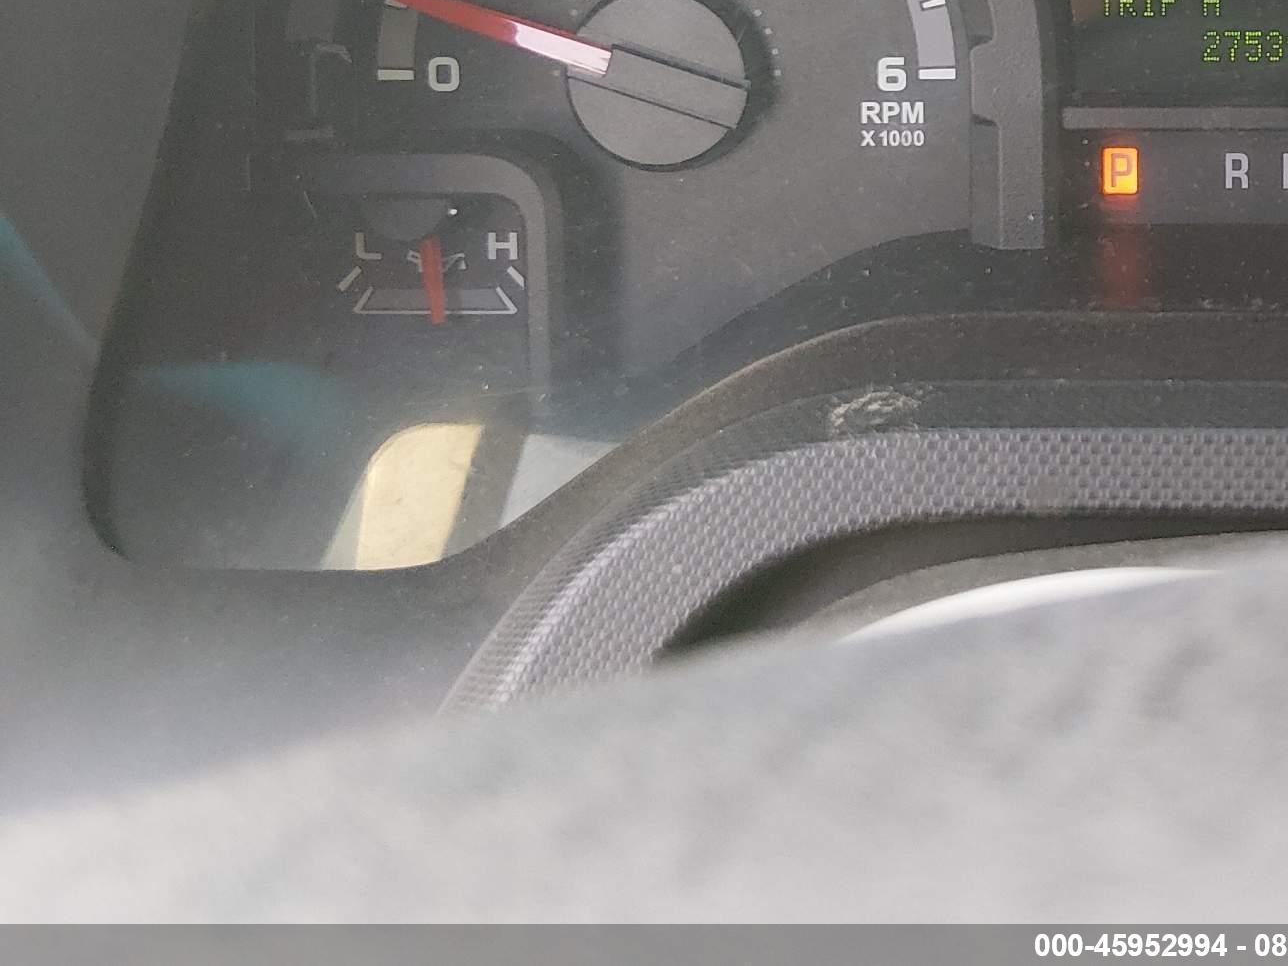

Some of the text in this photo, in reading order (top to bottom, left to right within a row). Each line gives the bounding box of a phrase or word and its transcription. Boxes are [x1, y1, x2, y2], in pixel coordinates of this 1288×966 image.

[427, 56, 460, 92] 0
[877, 56, 907, 92] 6
[861, 101, 924, 124] RPM
[1110, 153, 1133, 188] P
[1225, 152, 1249, 189] R
[355, 232, 383, 261] L
[487, 231, 518, 261] H
